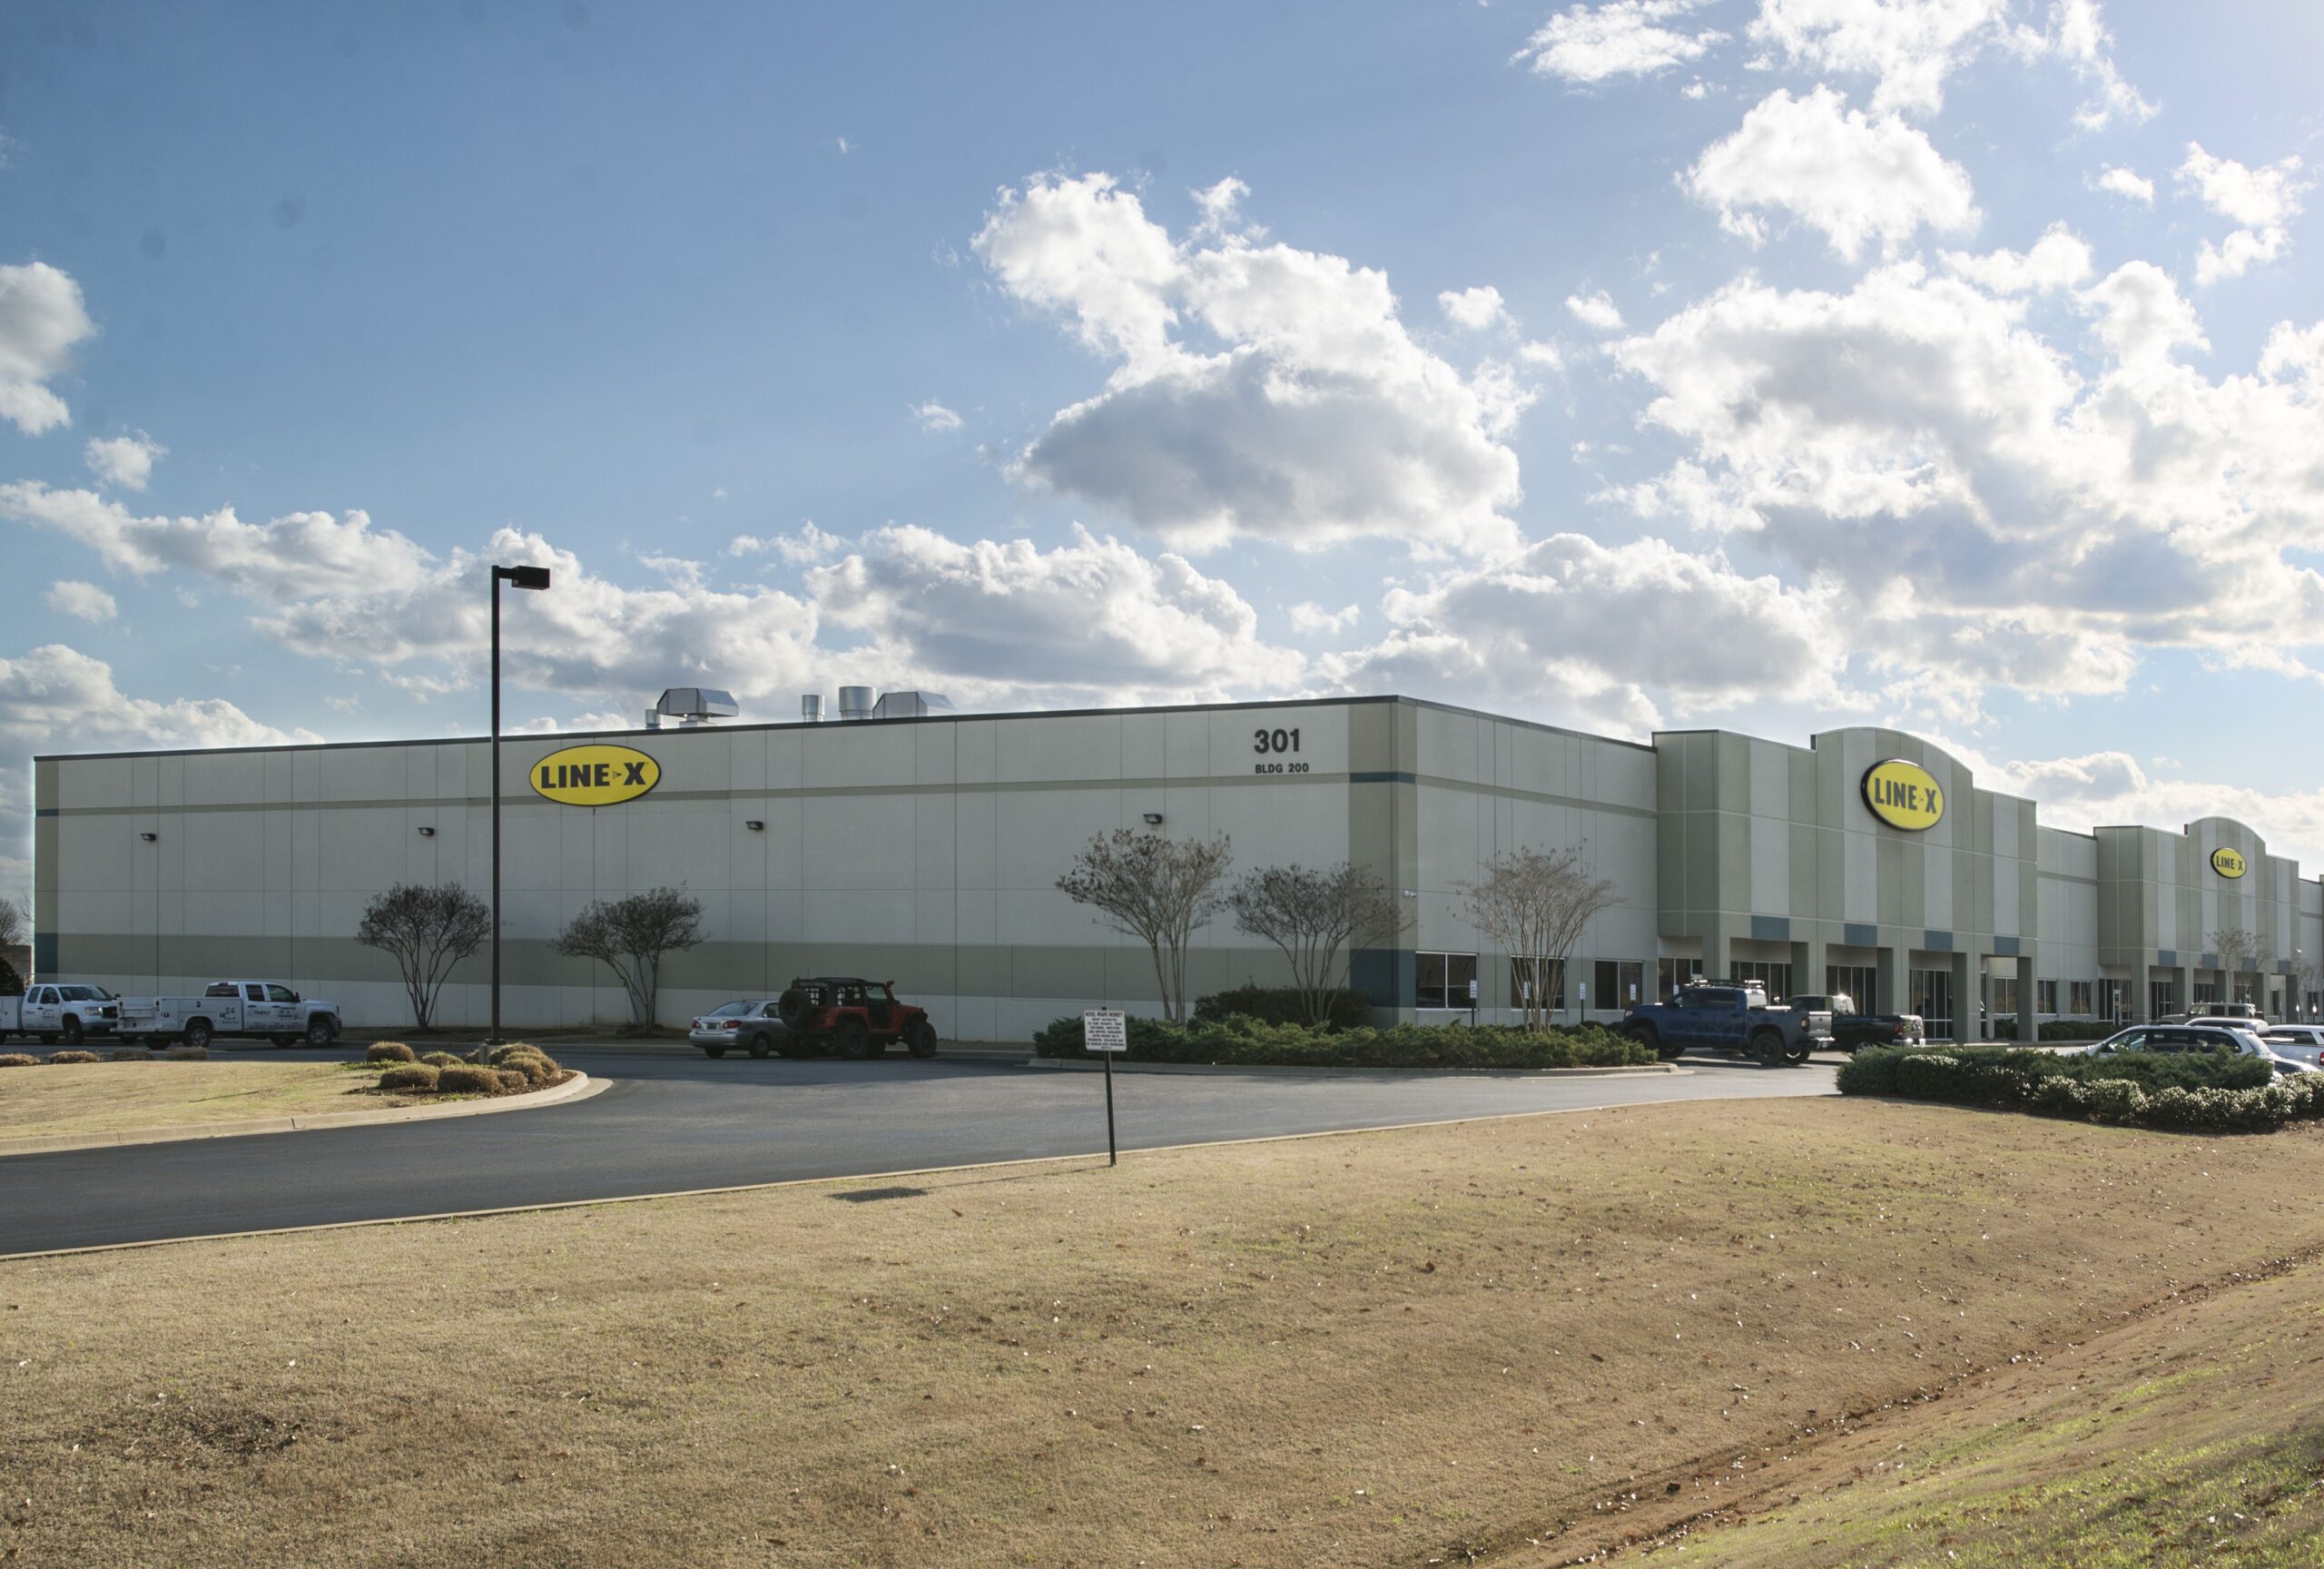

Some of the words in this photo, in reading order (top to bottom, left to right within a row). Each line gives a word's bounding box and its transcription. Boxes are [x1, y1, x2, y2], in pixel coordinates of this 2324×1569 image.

[1254, 728, 1299, 754] 301
[1256, 764, 1283, 774] BLDG
[1288, 763, 1309, 773] 200
